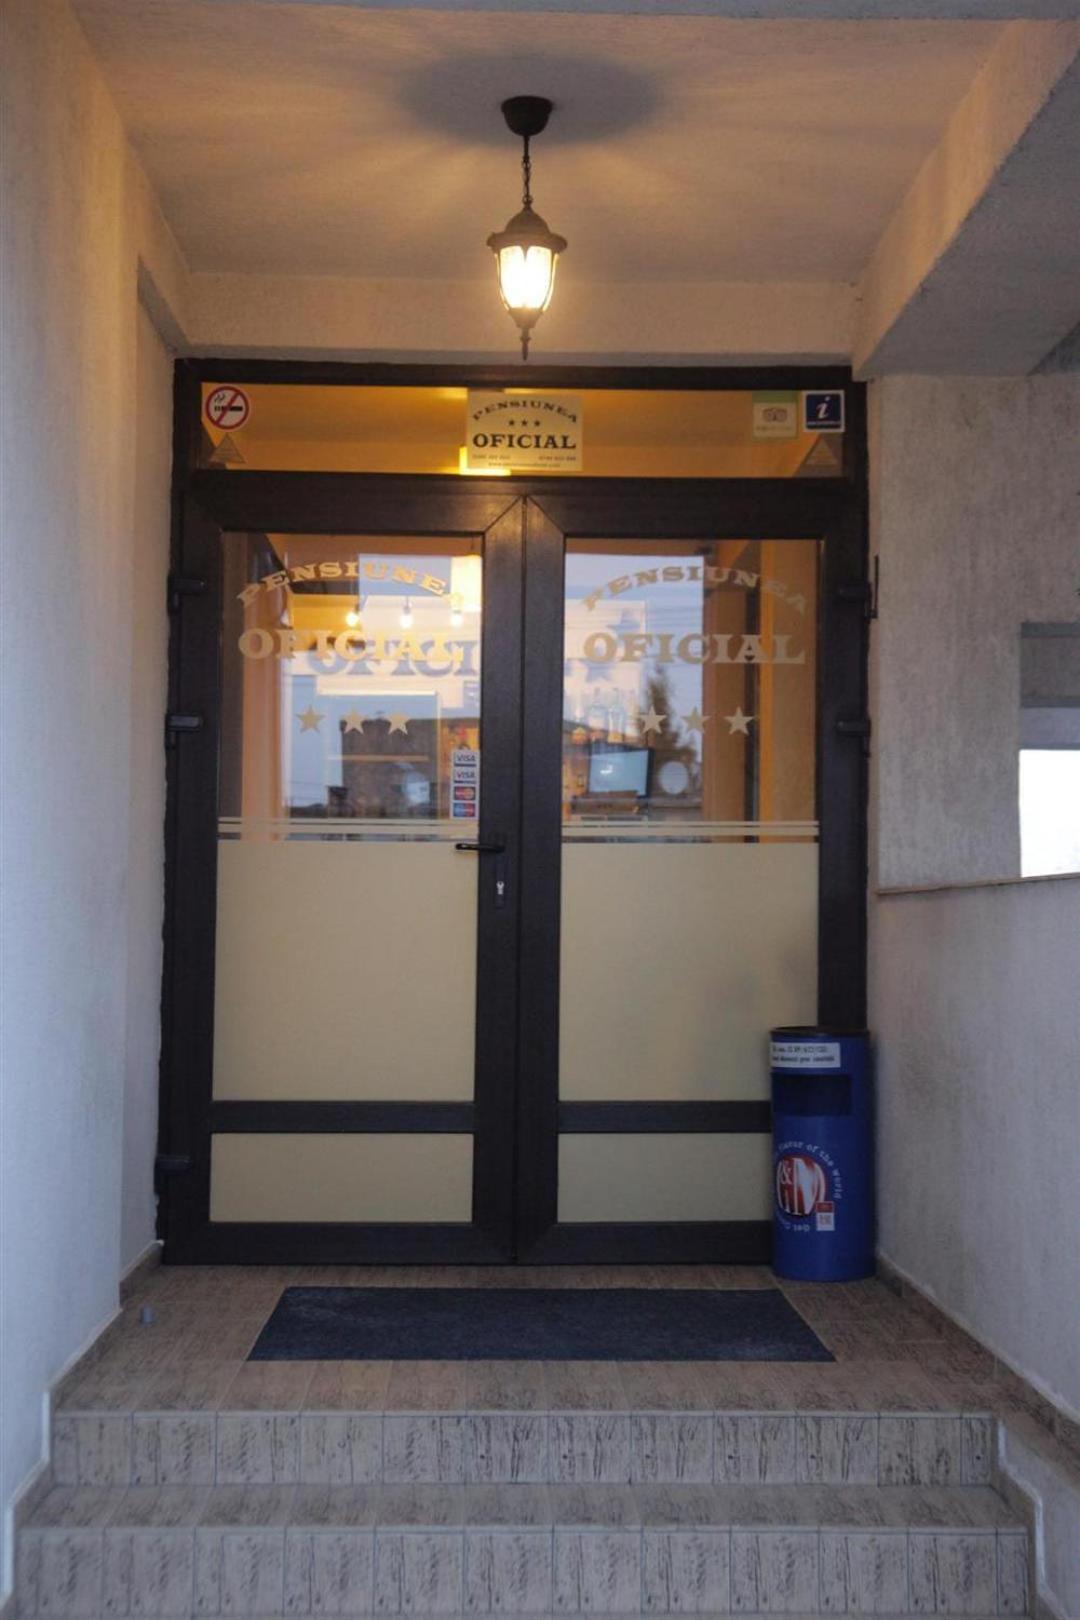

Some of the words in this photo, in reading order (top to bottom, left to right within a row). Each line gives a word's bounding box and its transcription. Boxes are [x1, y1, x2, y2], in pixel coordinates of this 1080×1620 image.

[472, 399, 577, 423] PENSIUNEA
[472, 433, 577, 449] OFICIAL
[582, 565, 808, 615] PENSIUNEA
[238, 628, 465, 661] OFICIAL
[583, 632, 806, 664] OFICIAL
[455, 754, 476, 763] VISA
[455, 771, 475, 780] VISA
